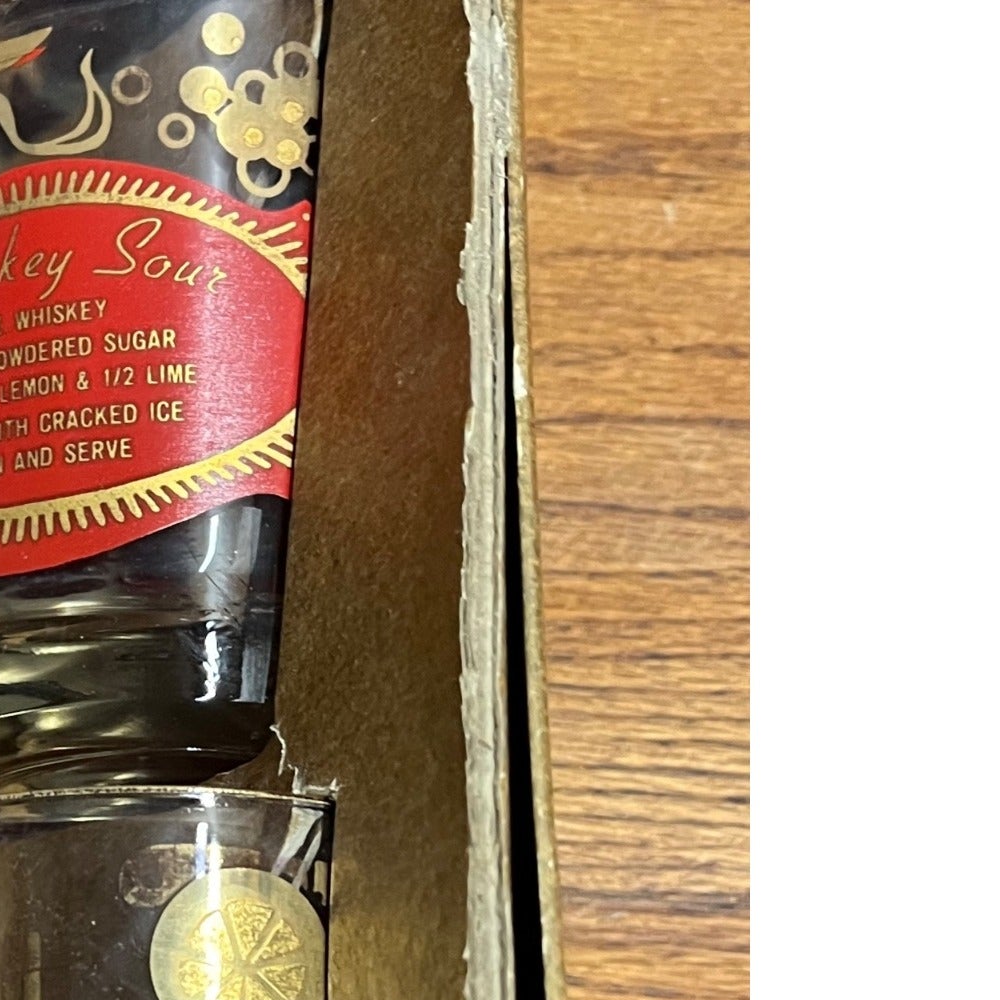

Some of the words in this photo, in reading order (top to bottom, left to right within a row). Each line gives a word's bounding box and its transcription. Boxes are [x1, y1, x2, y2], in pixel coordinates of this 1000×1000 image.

[92, 217, 229, 293] Sour
[15, 299, 107, 331] WHISKEY
[103, 329, 177, 353] SUGAR
[0, 375, 65, 404] LEMON
[76, 370, 89, 390] &
[102, 367, 135, 388] 1/2
[146, 363, 198, 386] LIME
[39, 404, 138, 433] CRACKED
[149, 400, 185, 422] ICE
[14, 445, 53, 471] AND
[64, 437, 133, 464] SERVE
